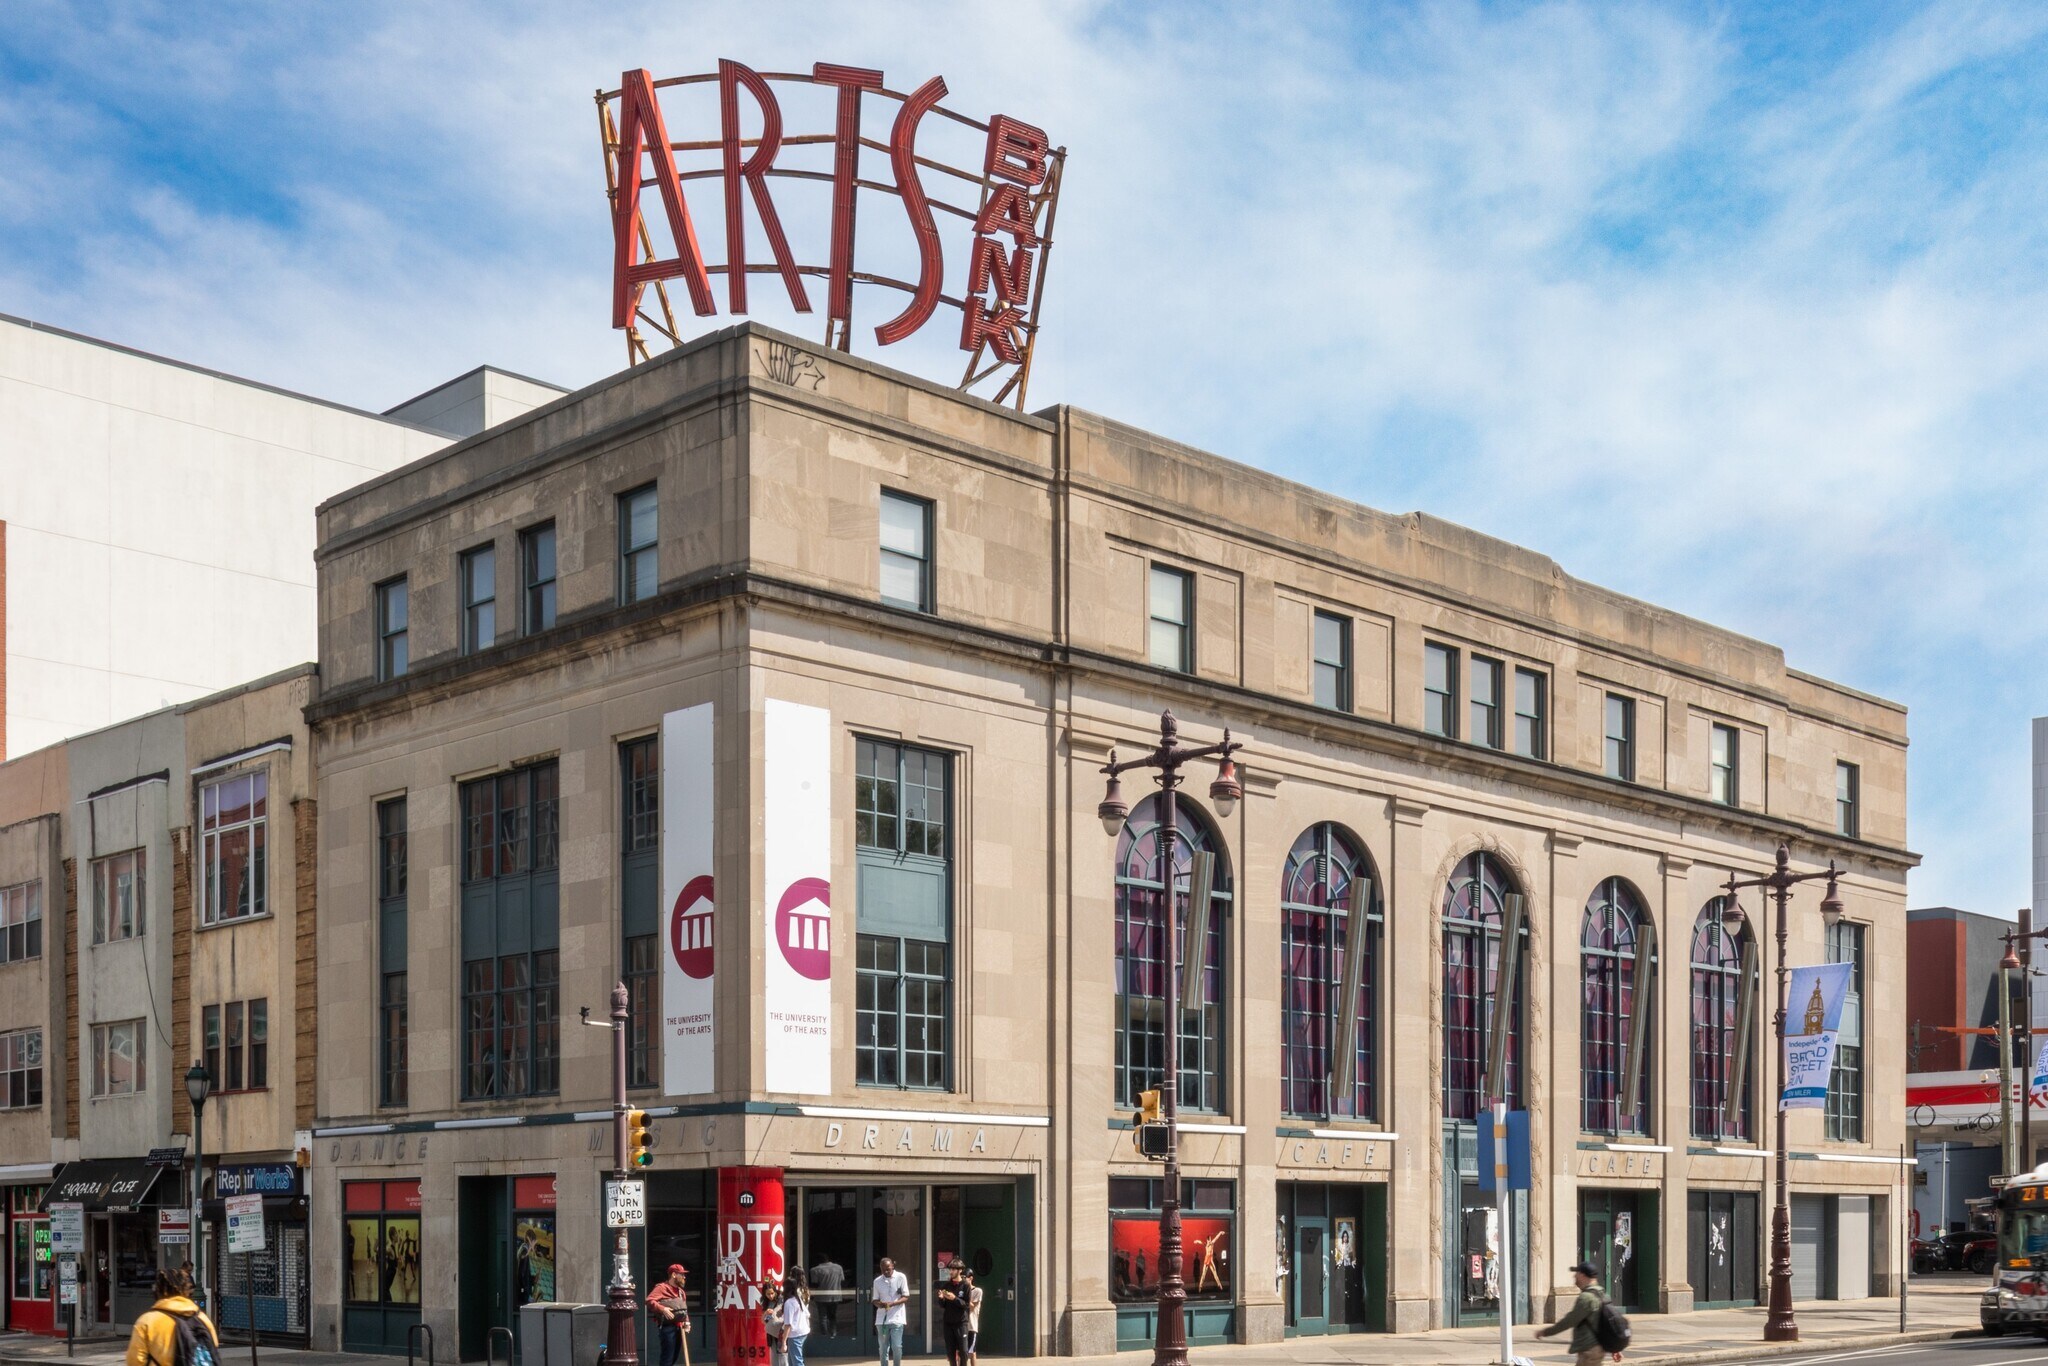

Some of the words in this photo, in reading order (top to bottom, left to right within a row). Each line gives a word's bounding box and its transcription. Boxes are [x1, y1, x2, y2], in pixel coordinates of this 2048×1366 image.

[613, 58, 949, 346] ARTS
[960, 114, 1049, 365] BANK
[667, 1017, 677, 1025] THE
[678, 1013, 711, 1024] UNIVERSITY
[770, 1012, 783, 1021] THE
[785, 1013, 827, 1024] UNIVERSITY
[677, 1028, 684, 1036] OF
[685, 1026, 696, 1035] THE
[697, 1025, 711, 1034] ARTS
[784, 1025, 793, 1033] OF
[795, 1025, 807, 1034] THE
[810, 1027, 827, 1036] ARTS
[589, 1120, 716, 1151] MSIC
[824, 1123, 987, 1153] DRAMA
[330, 1135, 428, 1162] DANCE
[1293, 1142, 1374, 1165] CAFE
[1589, 1154, 1652, 1174] CAFE
[60, 1182, 102, 1197] SAQQARA
[111, 1180, 140, 1193] CAFE
[614, 1199, 639, 1207] TURN
[610, 1211, 622, 1220] ON
[625, 1211, 643, 1219] RED
[716, 1285, 776, 1310] BAN
[732, 1344, 766, 1358] 1993
